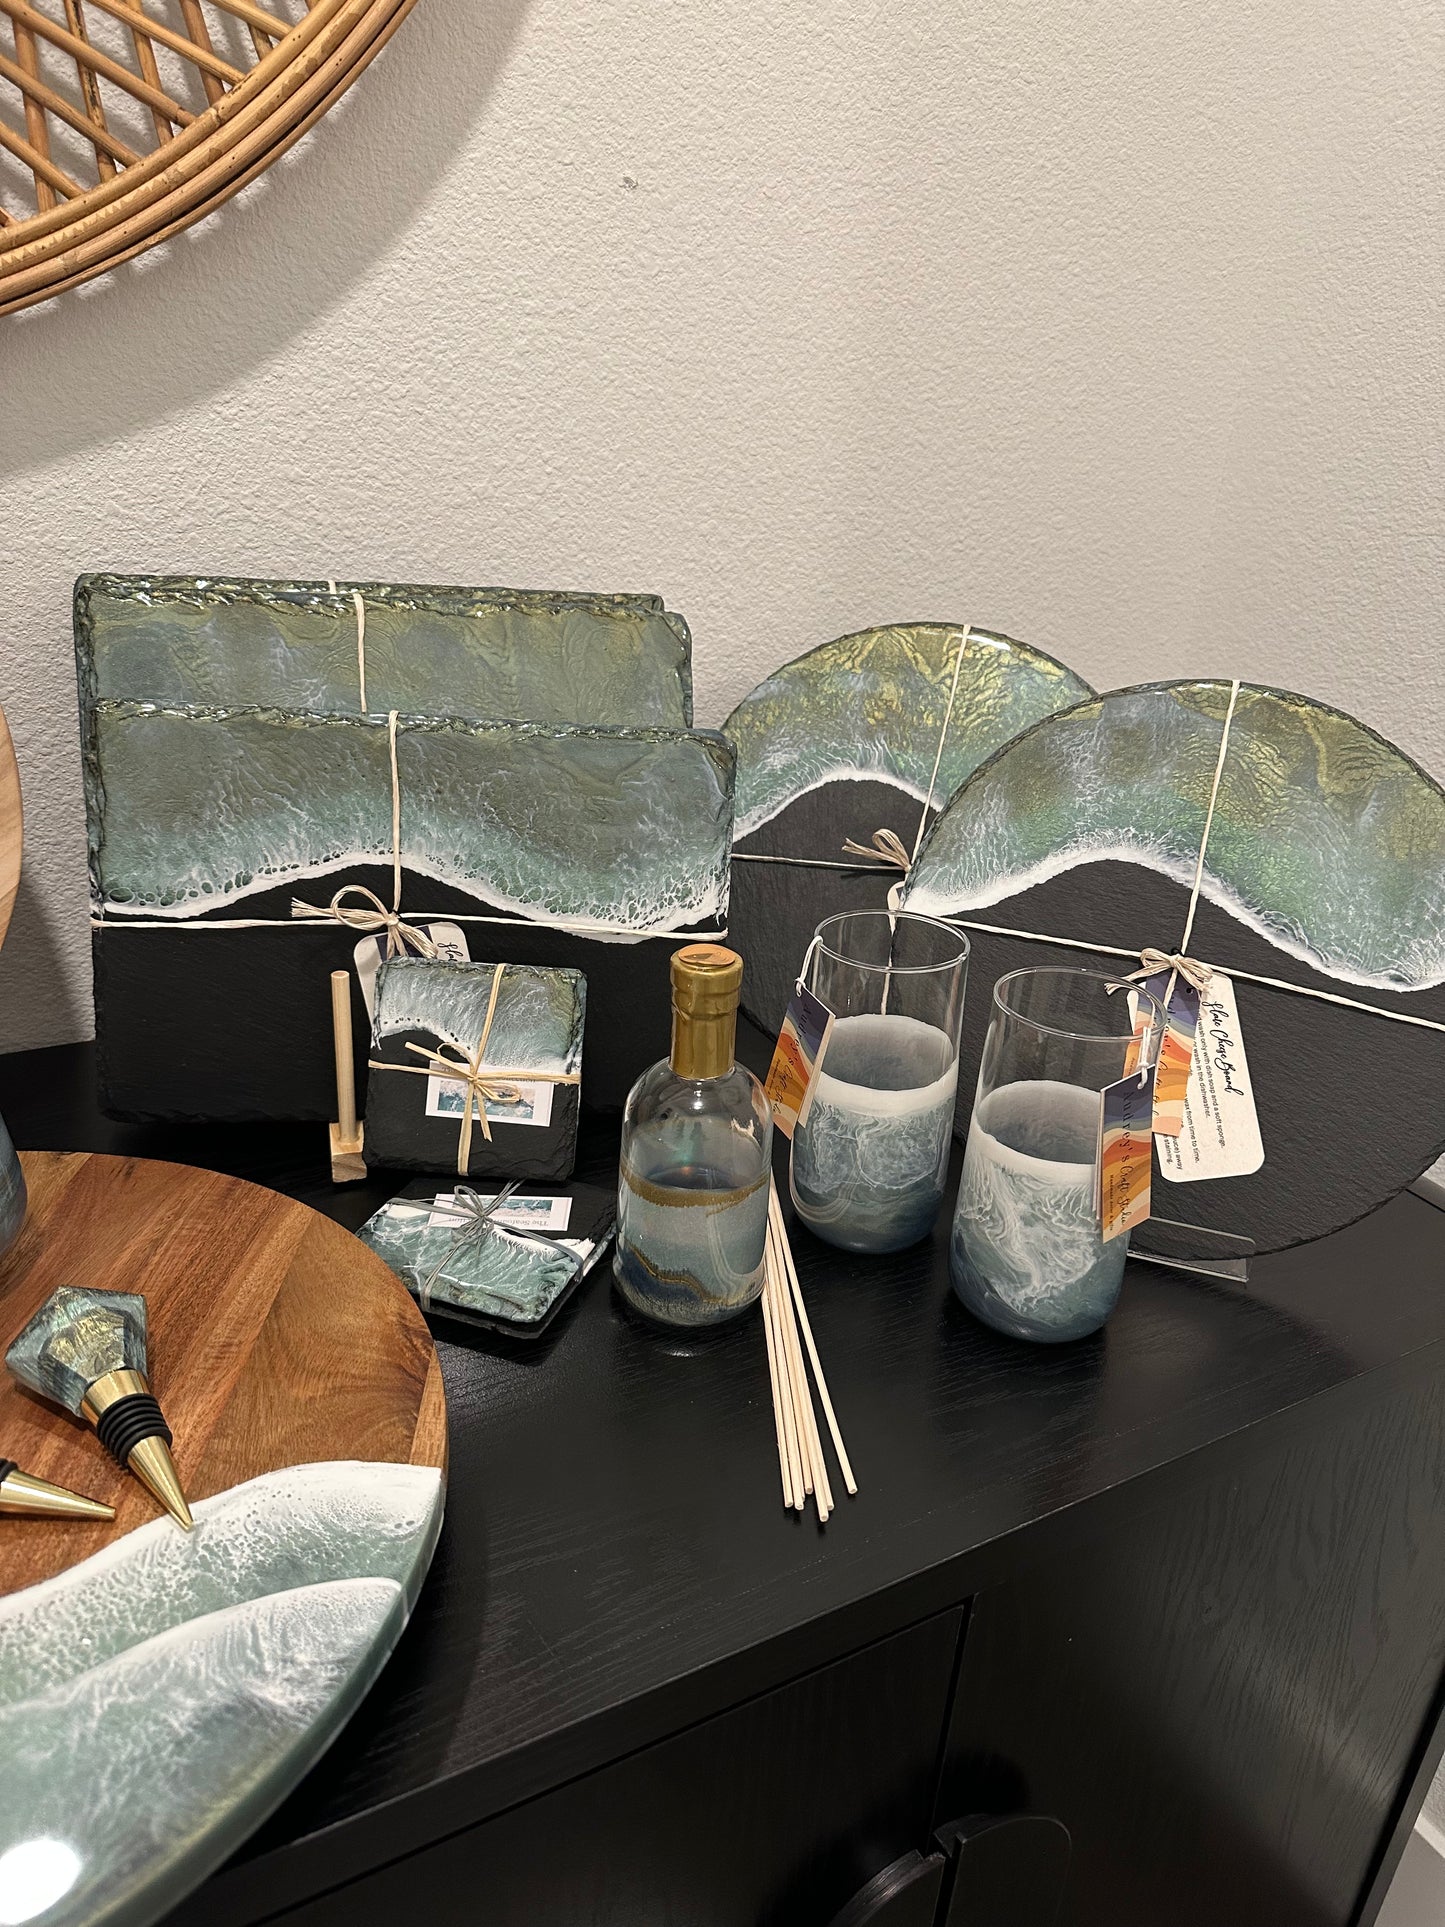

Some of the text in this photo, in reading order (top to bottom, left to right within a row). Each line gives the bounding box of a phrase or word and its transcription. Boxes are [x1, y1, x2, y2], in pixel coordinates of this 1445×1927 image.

[437, 942, 464, 961] Slat
[788, 1003, 813, 1066] Audrey's
[1200, 1039, 1208, 1052] only
[1202, 1001, 1244, 1096] Slate Cheese Board
[1193, 1049, 1201, 1065] wash
[1205, 1065, 1213, 1078] dish
[1208, 1079, 1216, 1093] soap
[1214, 1113, 1222, 1124] soft
[1117, 1091, 1135, 1225] Audrey's Craft Studio
[1175, 1154, 1183, 1170] away
[531, 1219, 549, 1227] The
